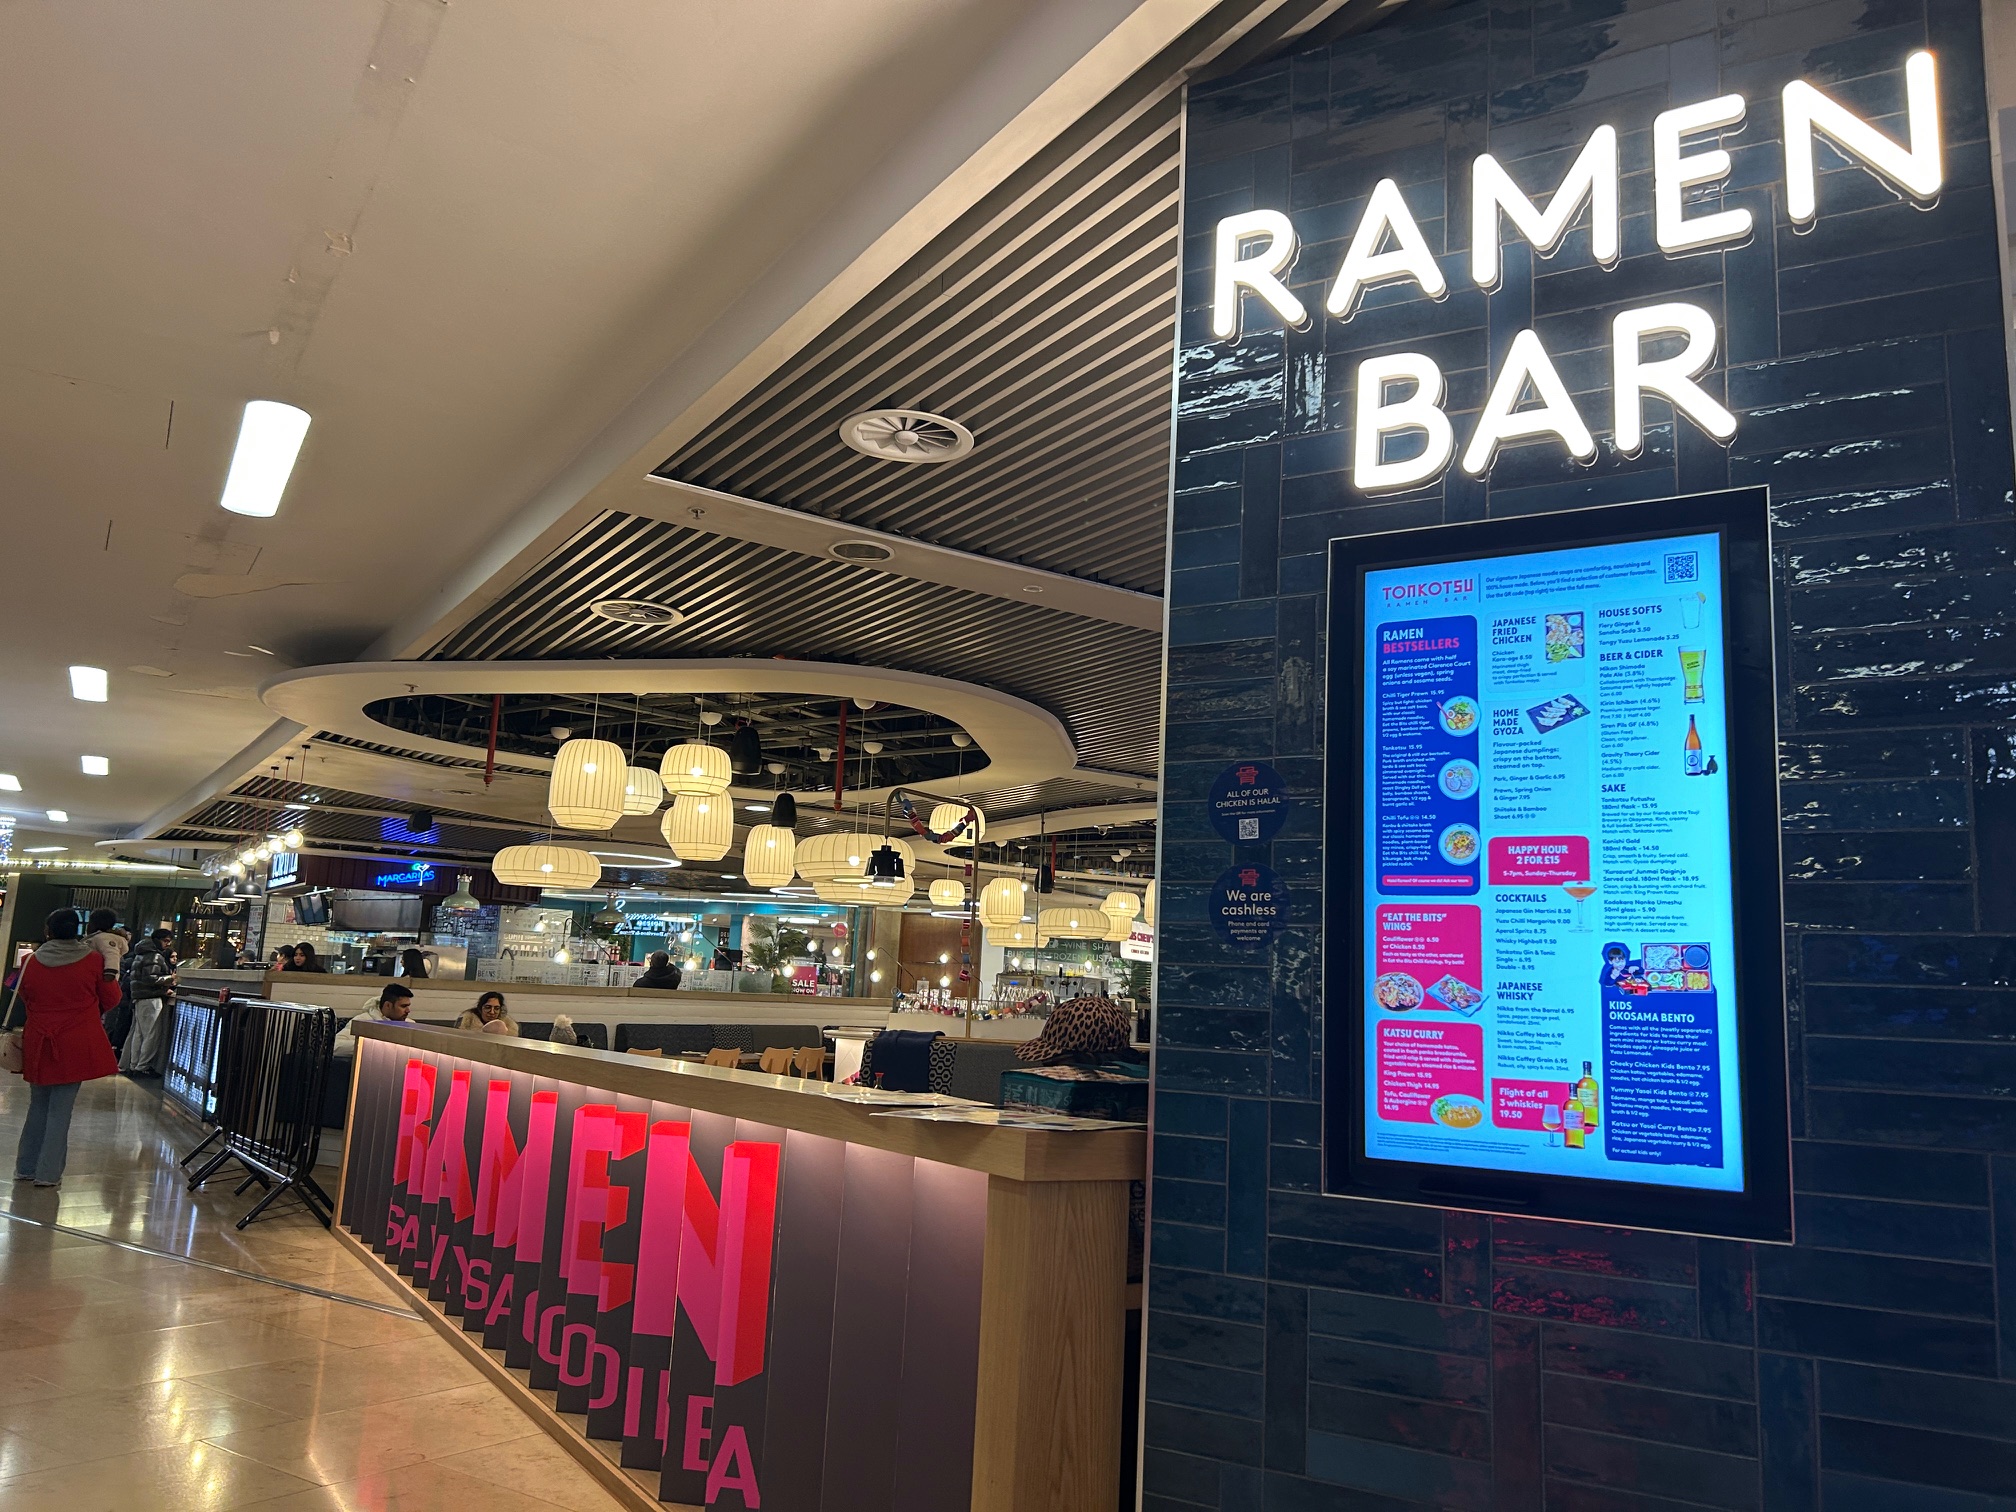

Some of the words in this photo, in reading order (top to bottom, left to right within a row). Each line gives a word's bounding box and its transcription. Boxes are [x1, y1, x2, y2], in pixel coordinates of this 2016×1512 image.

[1212, 50, 1944, 338] RAMEN
[1354, 301, 1738, 490] BAR
[1382, 579, 1473, 600] TONKOTSU
[1387, 600, 1427, 608] RAMEN
[1599, 607, 1630, 618] HOUSE
[1632, 605, 1662, 615] SOFTS
[1492, 616, 1536, 628] JAPANESE
[1384, 628, 1423, 642] RAMEN
[1493, 627, 1517, 636] FRIED
[1493, 635, 1531, 645] CHICKEN
[1383, 637, 1459, 654] BESTSELLERS
[1600, 653, 1623, 661] BEER
[1634, 650, 1663, 658] CIDER
[1493, 709, 1519, 717] HOME
[1493, 718, 1518, 726] MADE
[1493, 727, 1524, 735] GYOZA
[1602, 784, 1626, 792] SAKE
[1216, 800, 1247, 808] CHICKEN
[1508, 846, 1539, 854] HAPPY
[1541, 846, 1568, 854] HOUR
[1524, 856, 1543, 864] FOR
[1544, 855, 1560, 864] £15
[1227, 890, 1246, 901] We
[1251, 893, 1271, 901] are
[1496, 894, 1546, 902] COCKTAILS
[1222, 904, 1276, 915] cashless
[1383, 923, 1411, 931] WINGS
[792, 979, 814, 988] SALE
[1497, 982, 1542, 991] JAPANESE
[1497, 991, 1534, 1000] WHISKY
[1609, 1001, 1632, 1010] KIDS
[1610, 1011, 1659, 1021] OKOSAMA
[1661, 1013, 1694, 1023] BENTO
[1384, 1029, 1412, 1038] KATSU
[1414, 1030, 1444, 1039] CURRY
[1500, 1088, 1523, 1099] Flight
[1536, 1090, 1549, 1098] all
[1507, 1100, 1543, 1109] whiskies
[1500, 1110, 1522, 1118] 19.50
